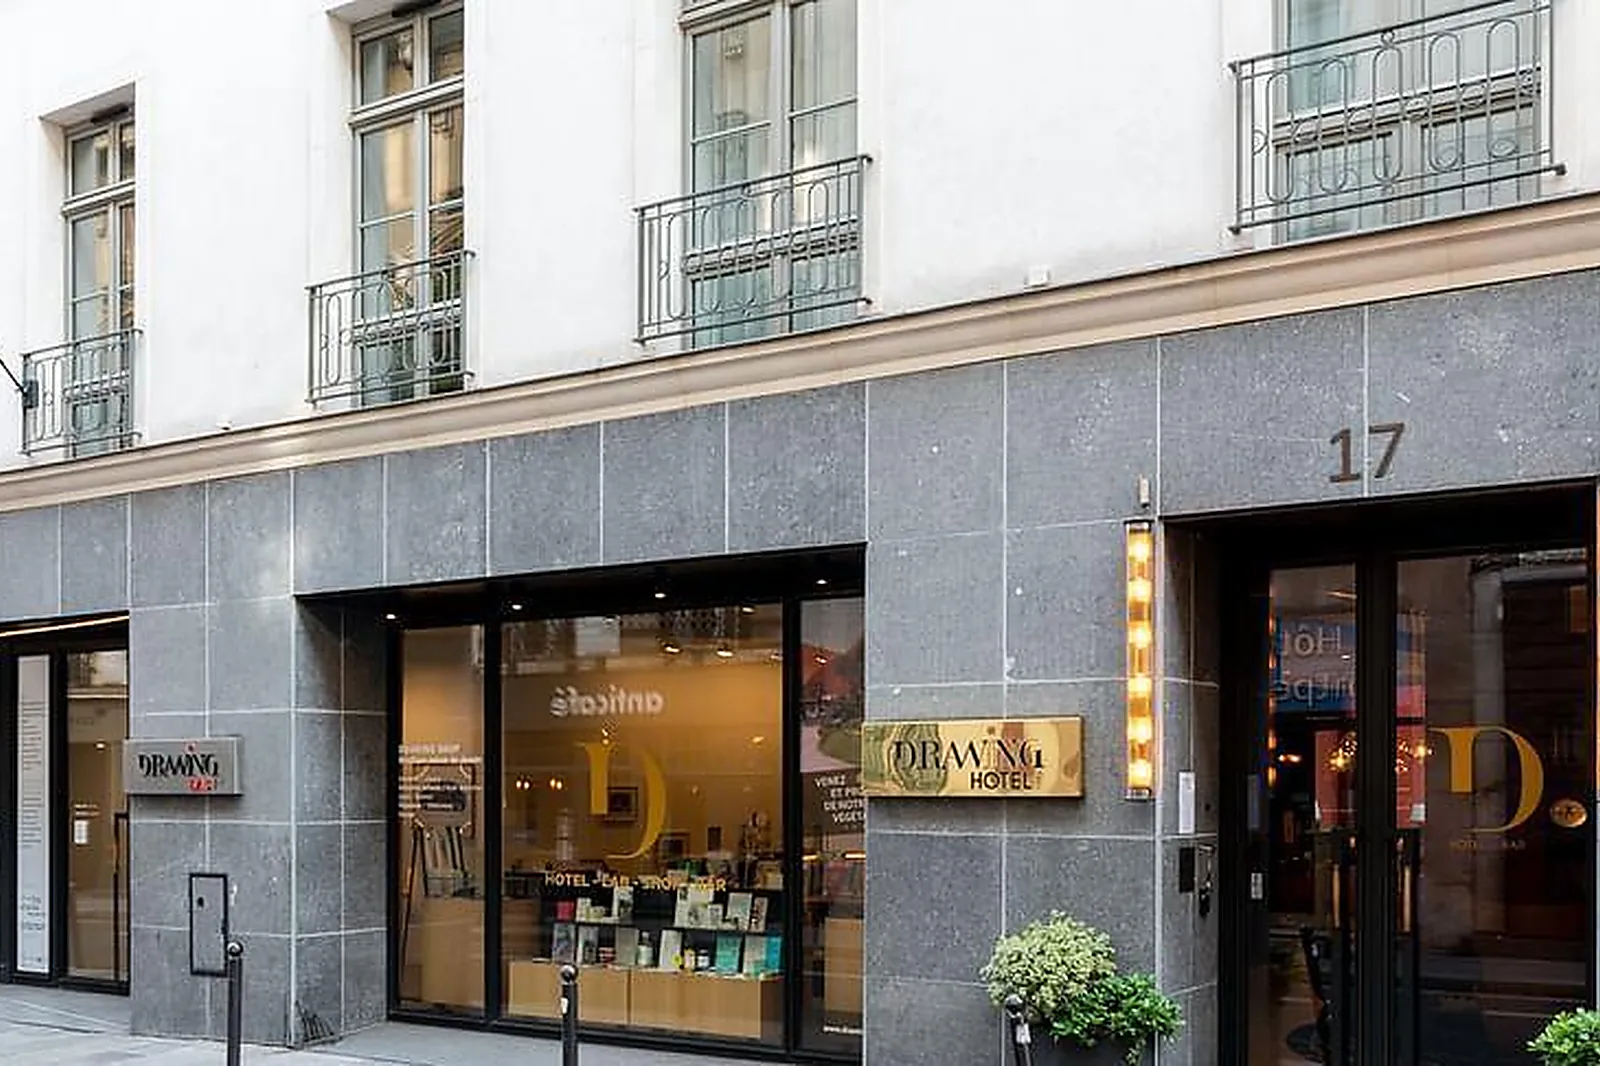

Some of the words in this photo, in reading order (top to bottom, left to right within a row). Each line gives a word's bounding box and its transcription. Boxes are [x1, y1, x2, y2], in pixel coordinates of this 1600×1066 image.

[1330, 421, 1404, 483] 17
[138, 747, 218, 778] DRAWING
[893, 727, 1044, 770] DRAWING
[970, 771, 1032, 790] HOTEL
[544, 871, 591, 888] HOTEL
